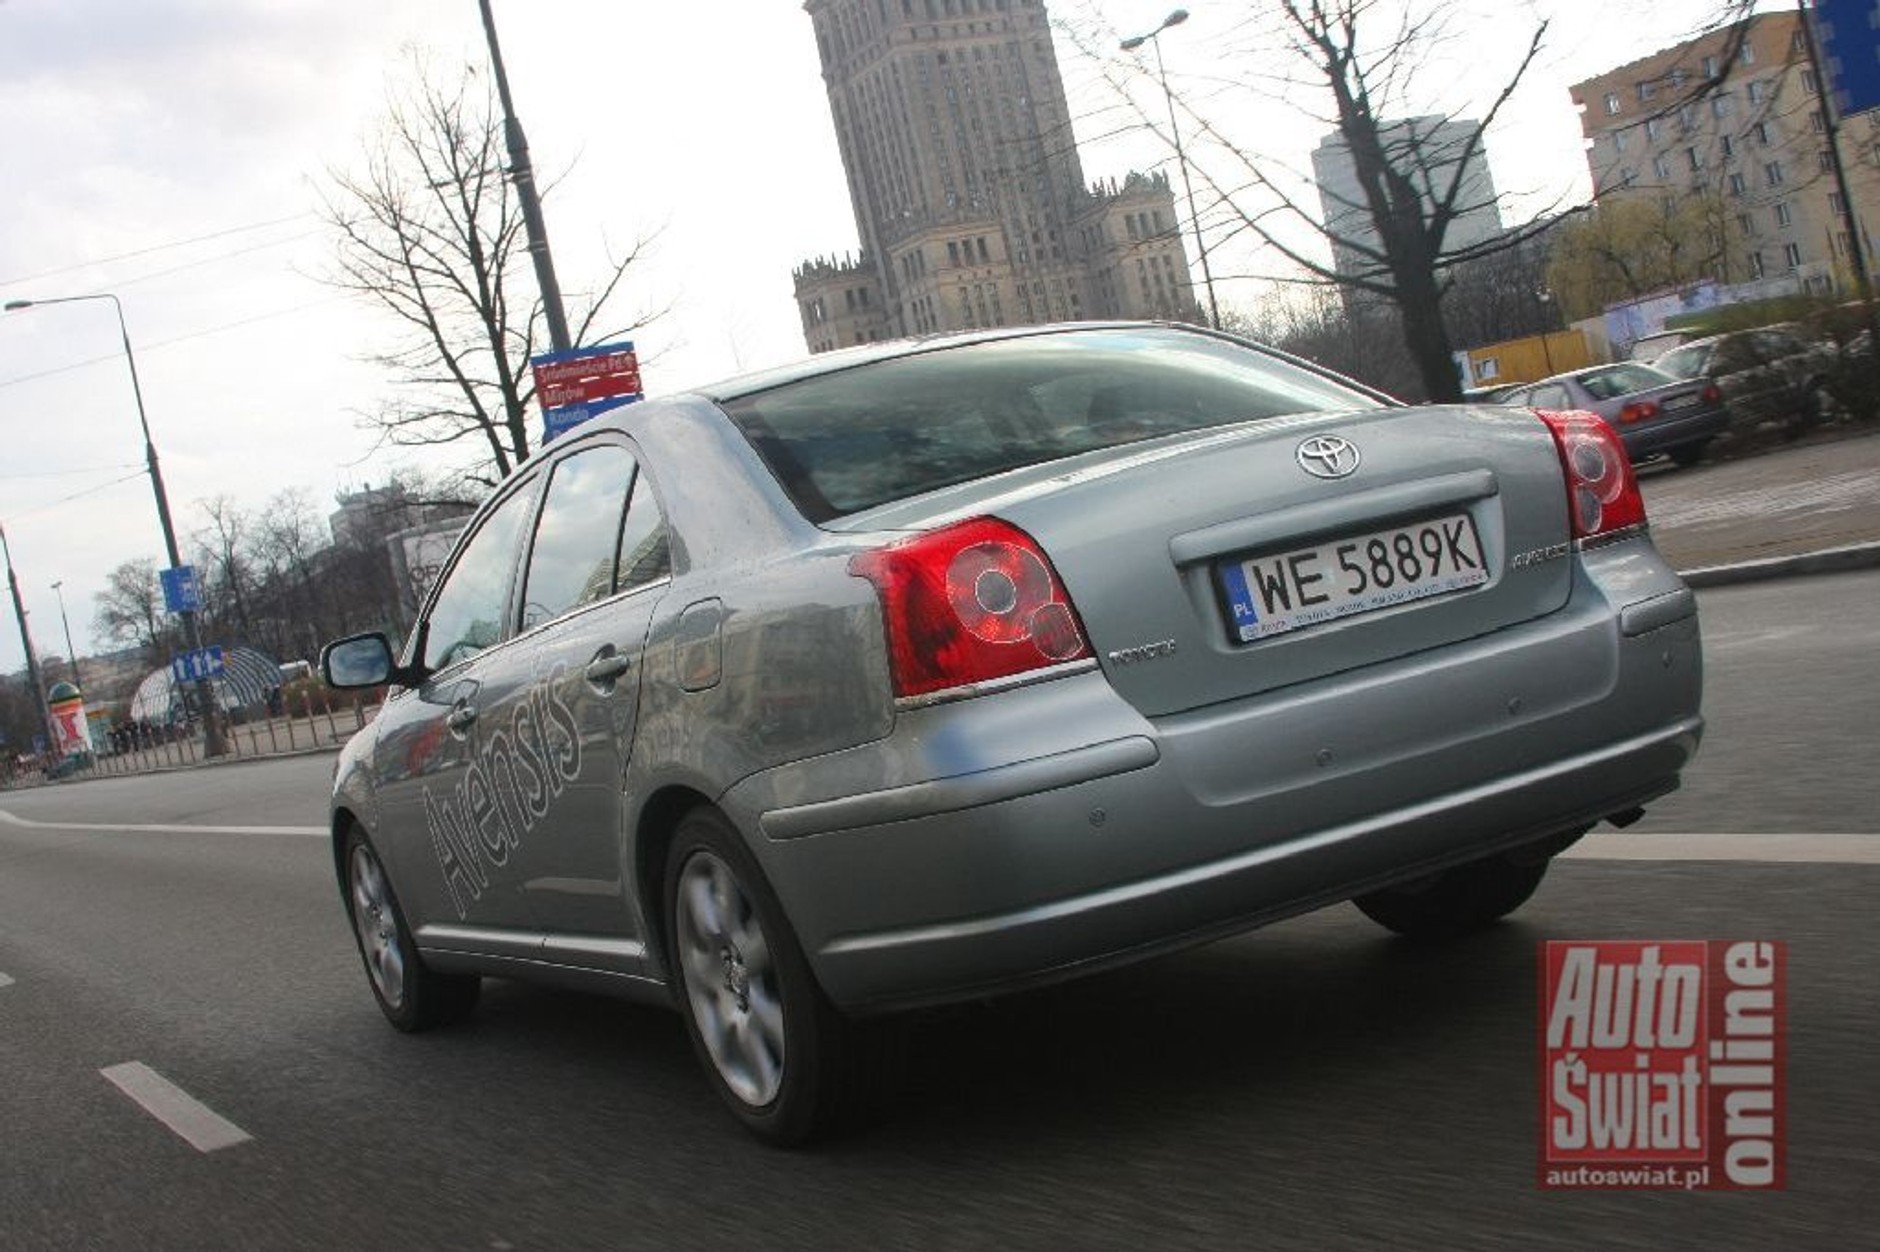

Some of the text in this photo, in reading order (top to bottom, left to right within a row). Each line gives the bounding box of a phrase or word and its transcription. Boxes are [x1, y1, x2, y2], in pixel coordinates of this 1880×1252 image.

[1233, 602, 1252, 618] PL
[1252, 553, 1330, 614] WE
[1336, 520, 1477, 595] 5889K
[422, 658, 581, 920] Avensis
